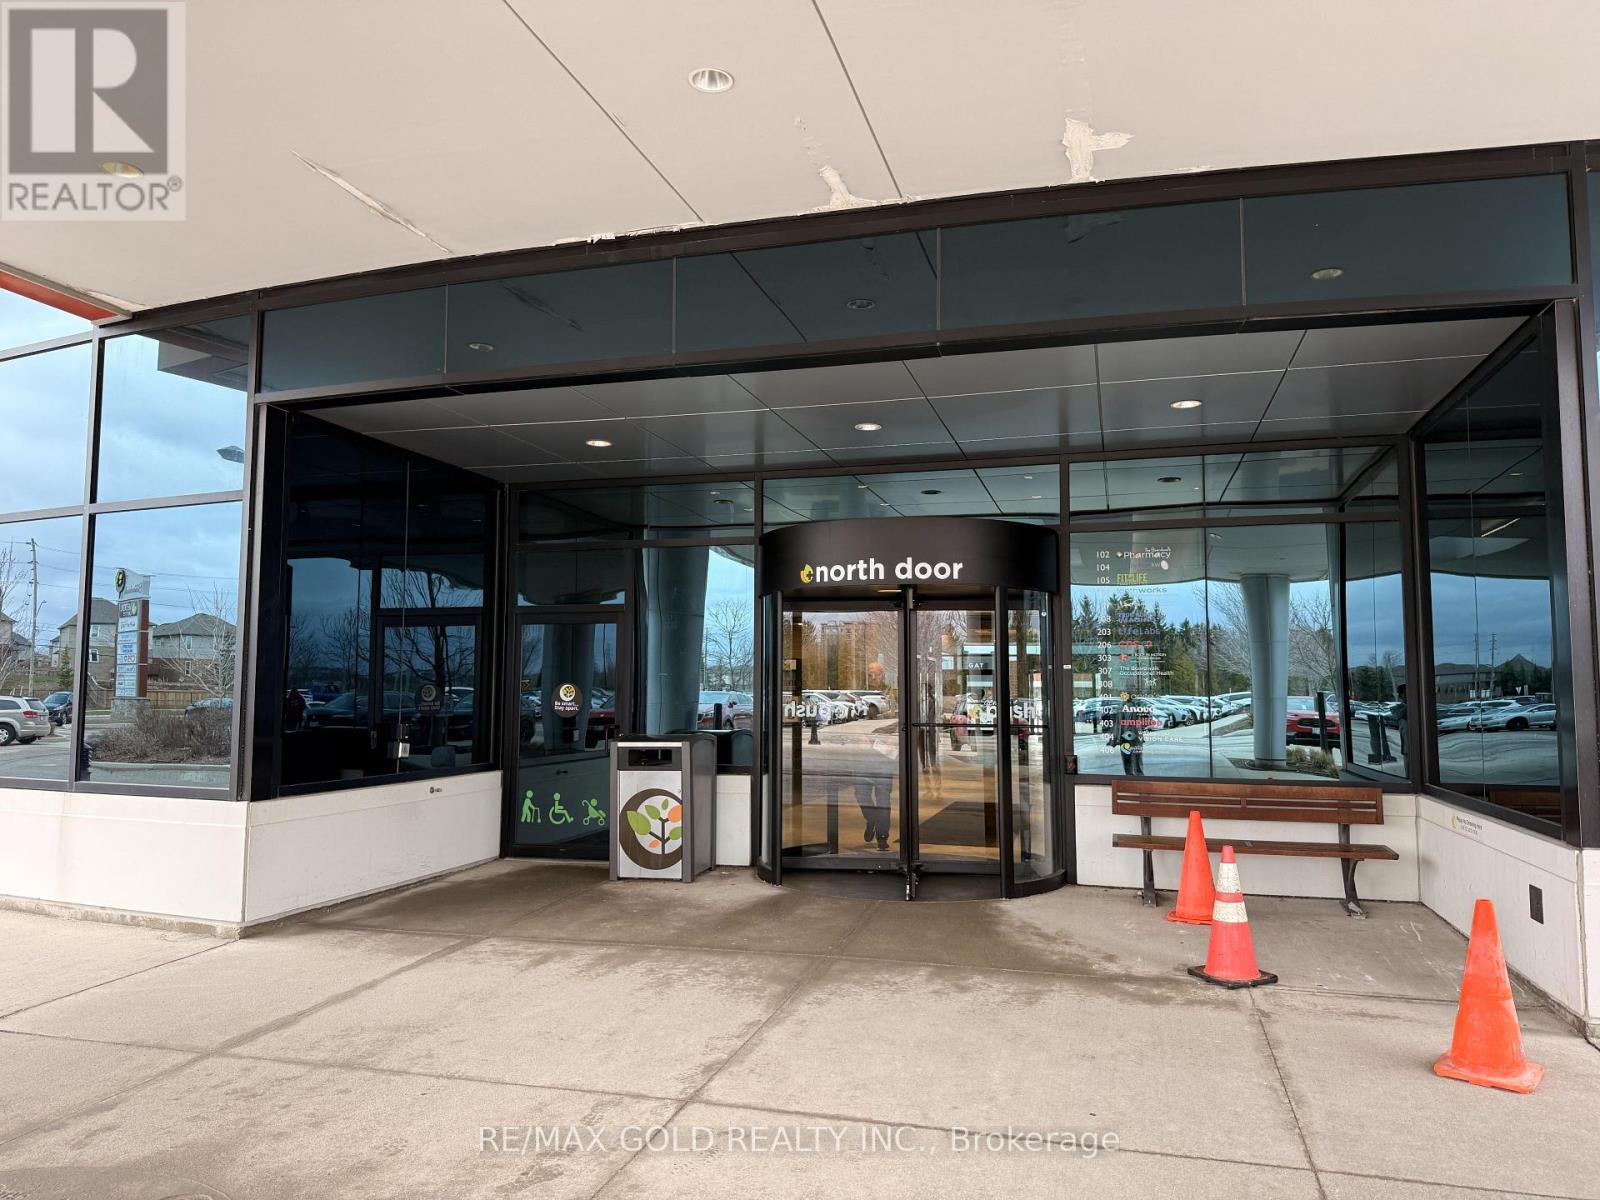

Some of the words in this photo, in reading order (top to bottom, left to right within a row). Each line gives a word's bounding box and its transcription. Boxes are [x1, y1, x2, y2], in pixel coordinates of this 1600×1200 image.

[1096, 551, 1110, 559] 102
[1123, 551, 1171, 560] Pharmacy
[816, 557, 885, 583] north
[895, 557, 963, 580] door
[1096, 564, 1110, 572] 104
